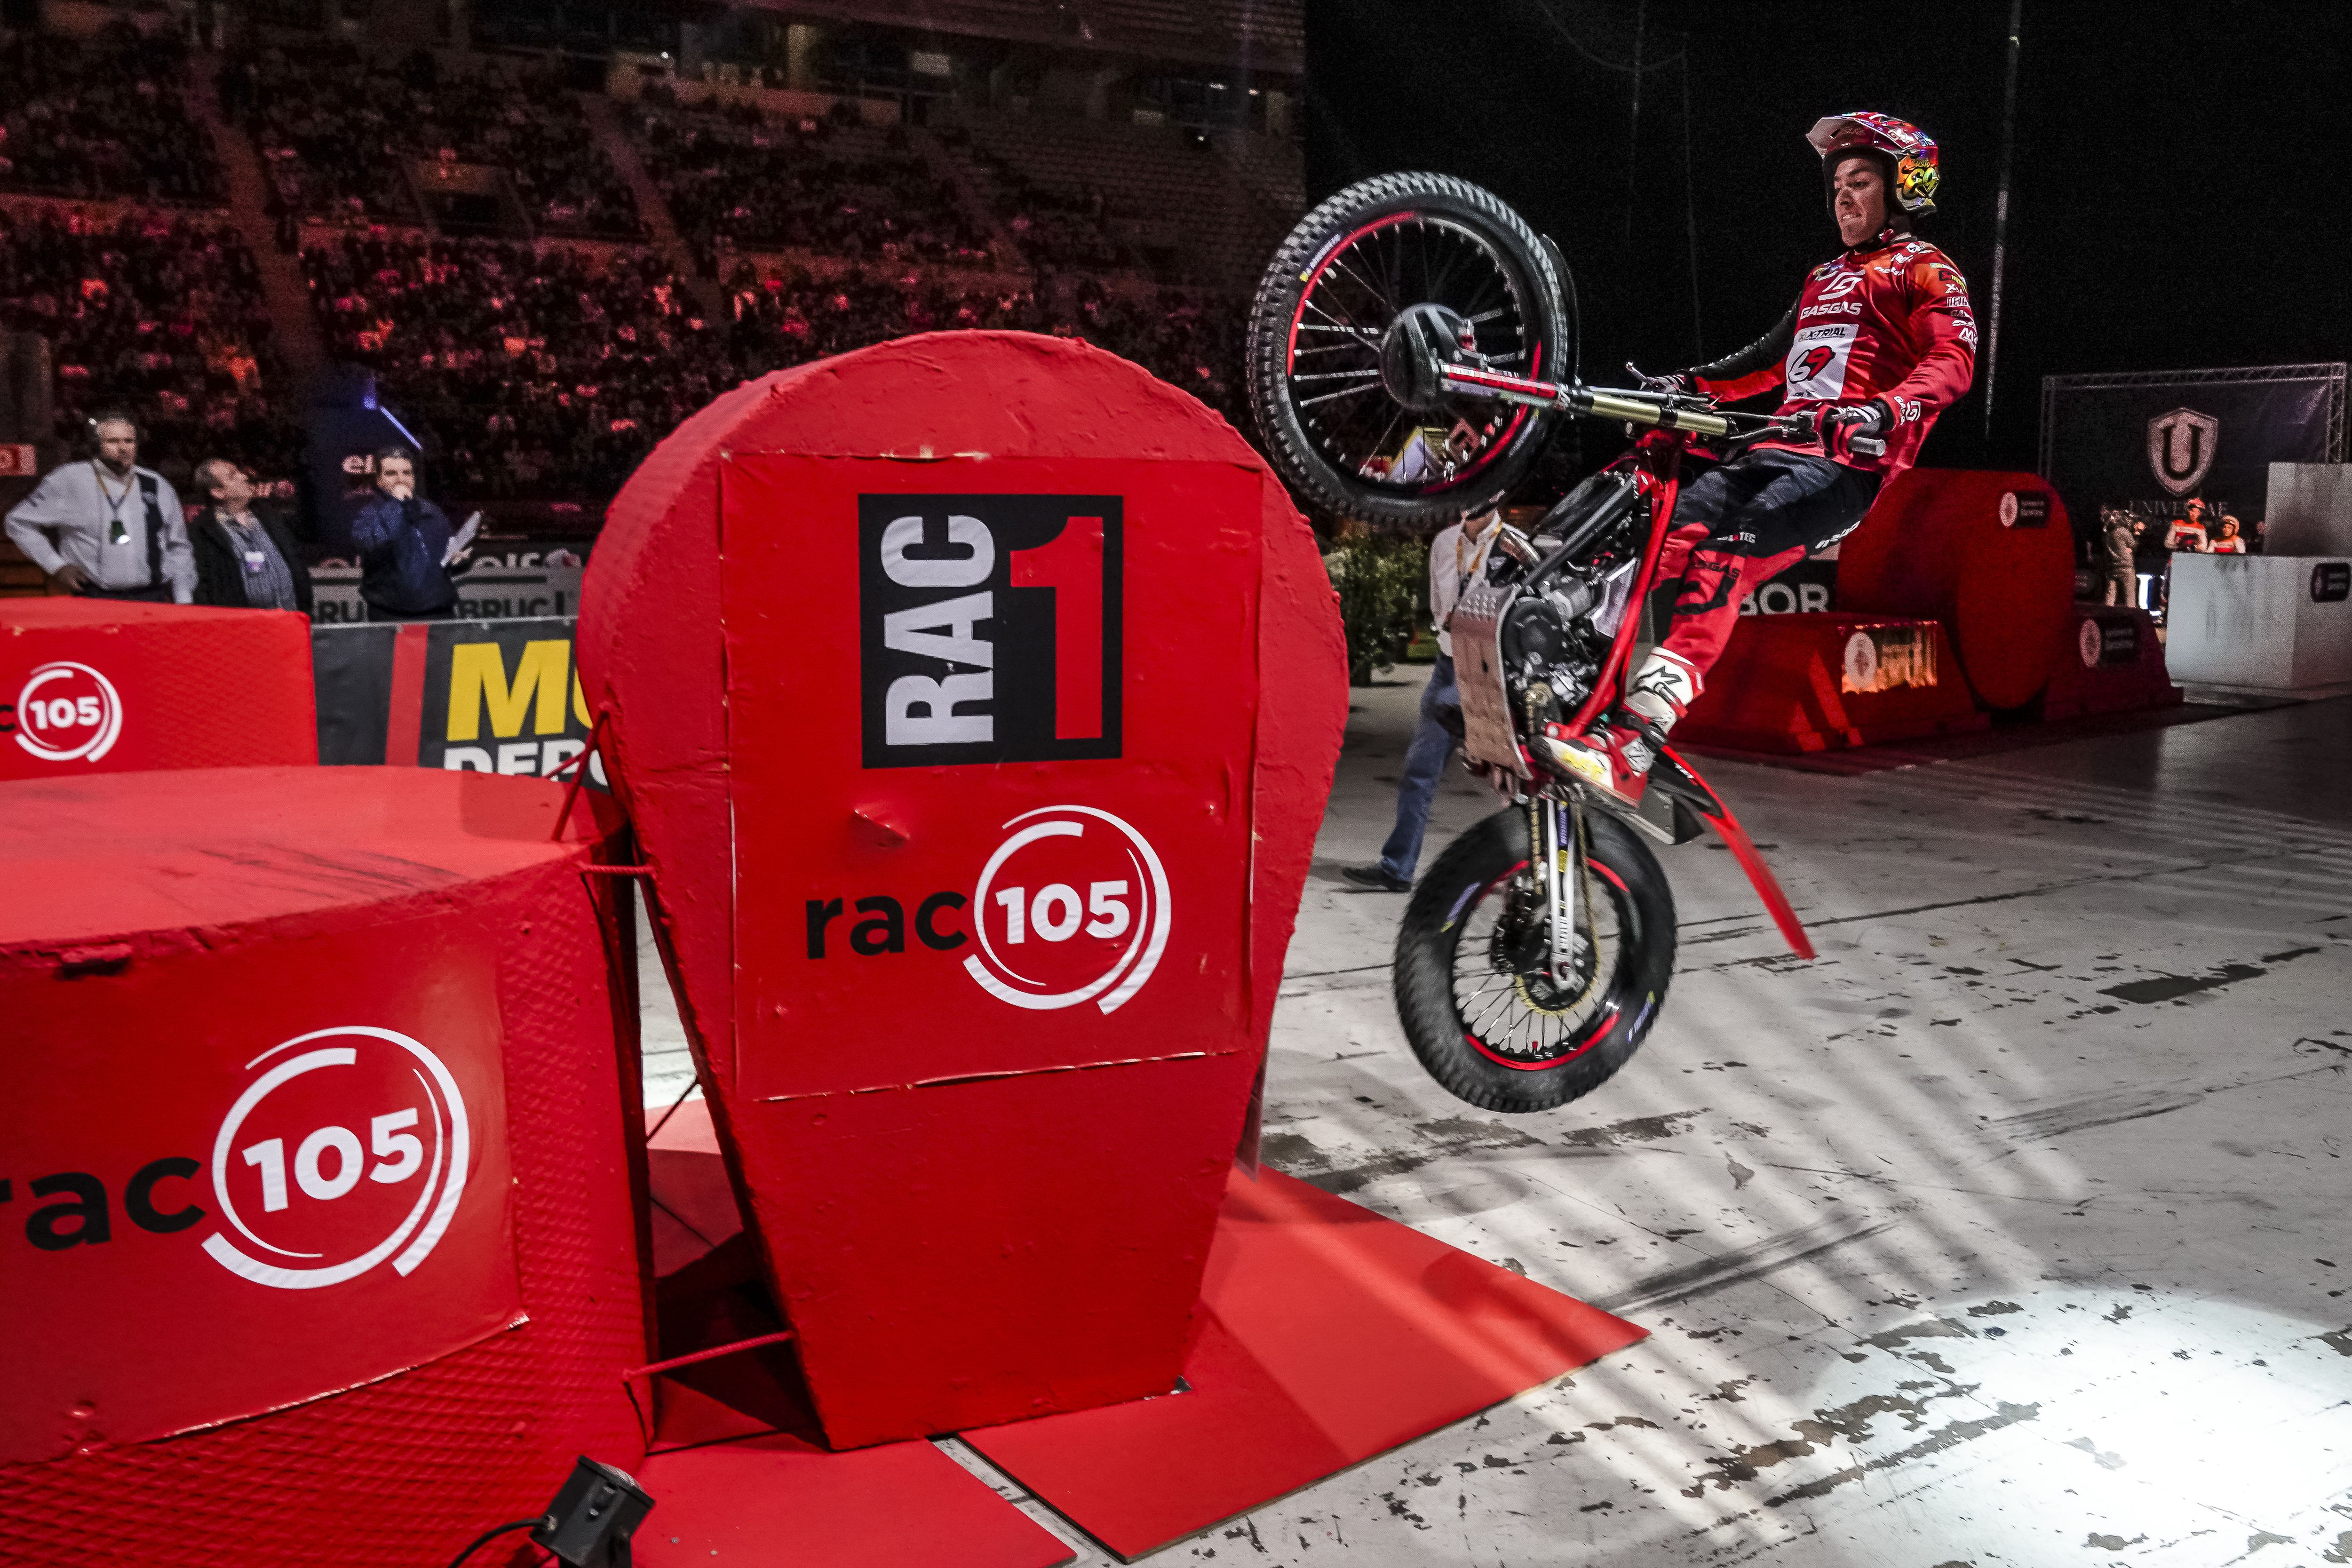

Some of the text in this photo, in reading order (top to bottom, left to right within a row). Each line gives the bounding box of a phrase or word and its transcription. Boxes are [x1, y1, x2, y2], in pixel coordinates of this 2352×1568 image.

[1800, 301, 1863, 320] GASGAS
[1807, 327, 1846, 338] X-TRIAL
[1788, 346, 1836, 384] 69
[881, 515, 1104, 745] RAC 1
[29, 696, 101, 730] 105
[805, 880, 1130, 959] rac 105
[0, 1108, 423, 1251] ac 105
